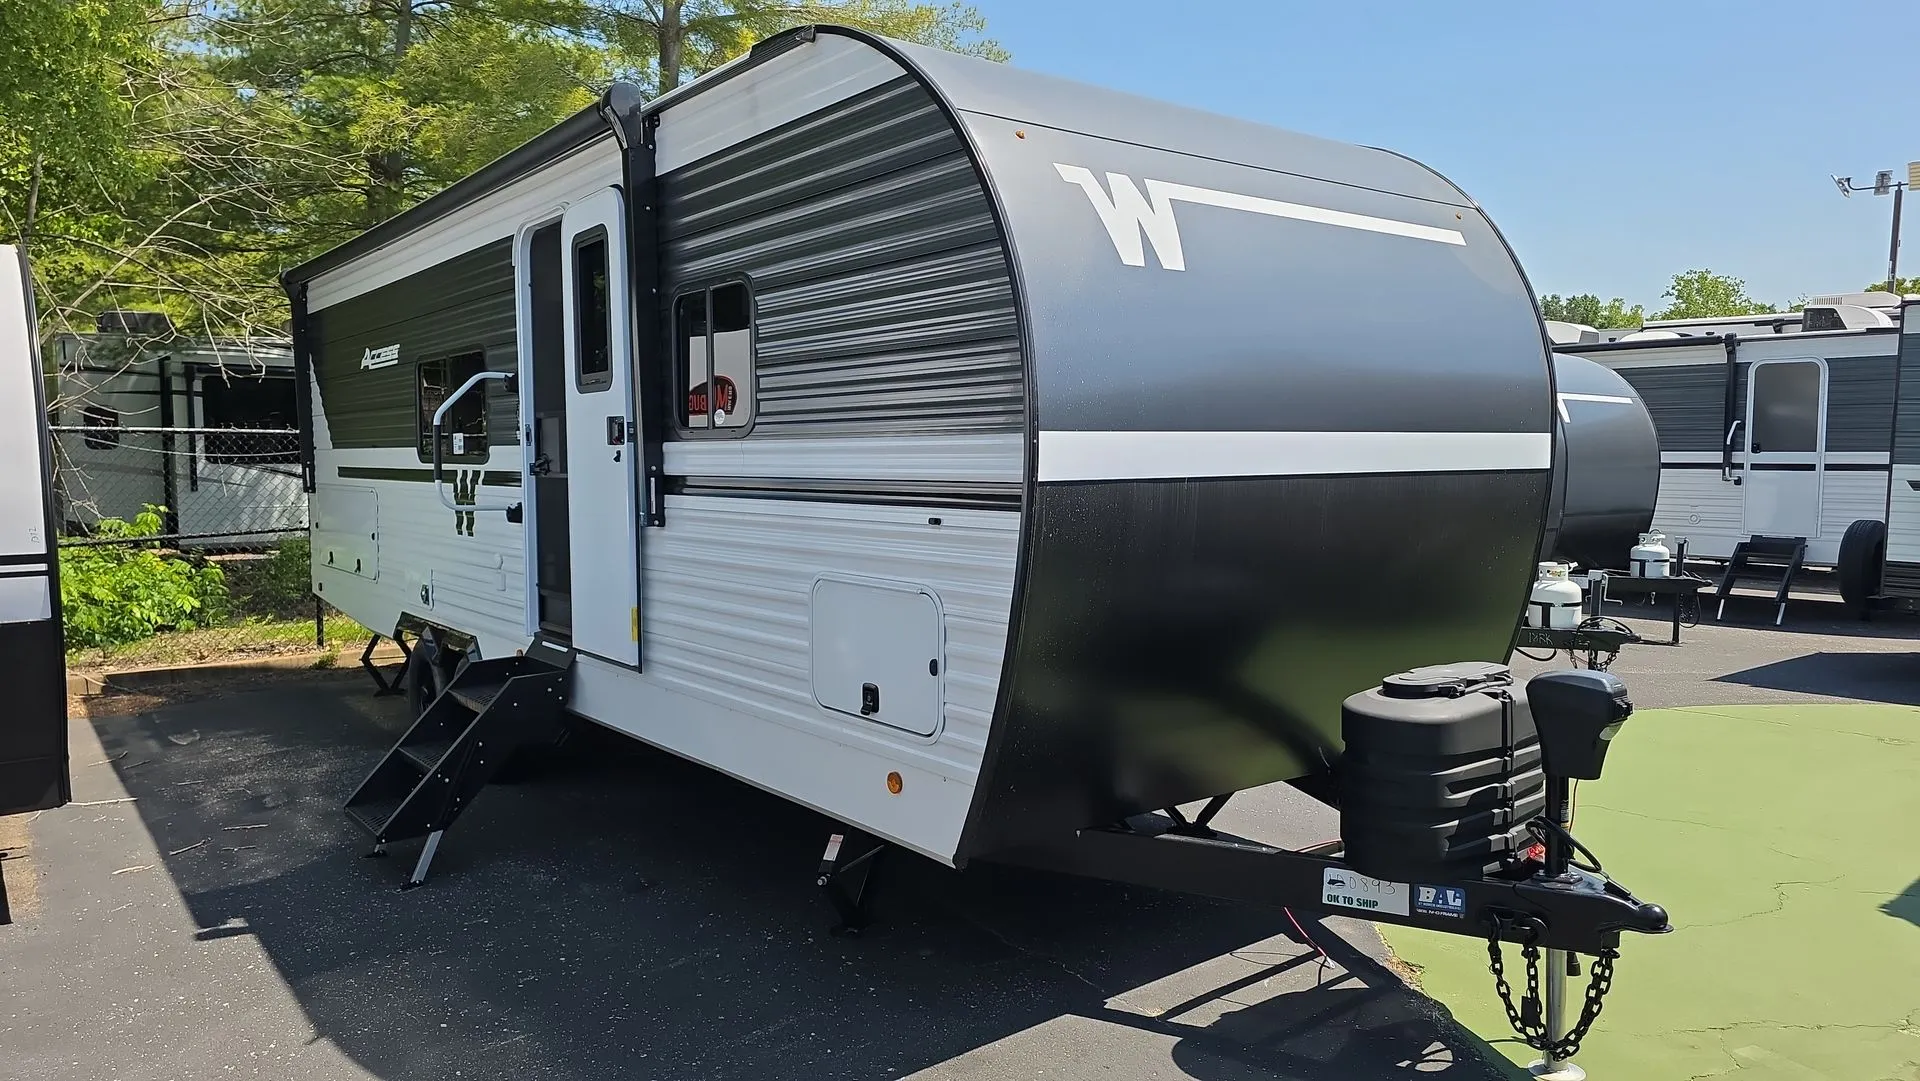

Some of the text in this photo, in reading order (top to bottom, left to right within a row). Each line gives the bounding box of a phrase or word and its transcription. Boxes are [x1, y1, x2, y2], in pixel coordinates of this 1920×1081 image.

[1326, 893, 1379, 909] OK TO SHIP
